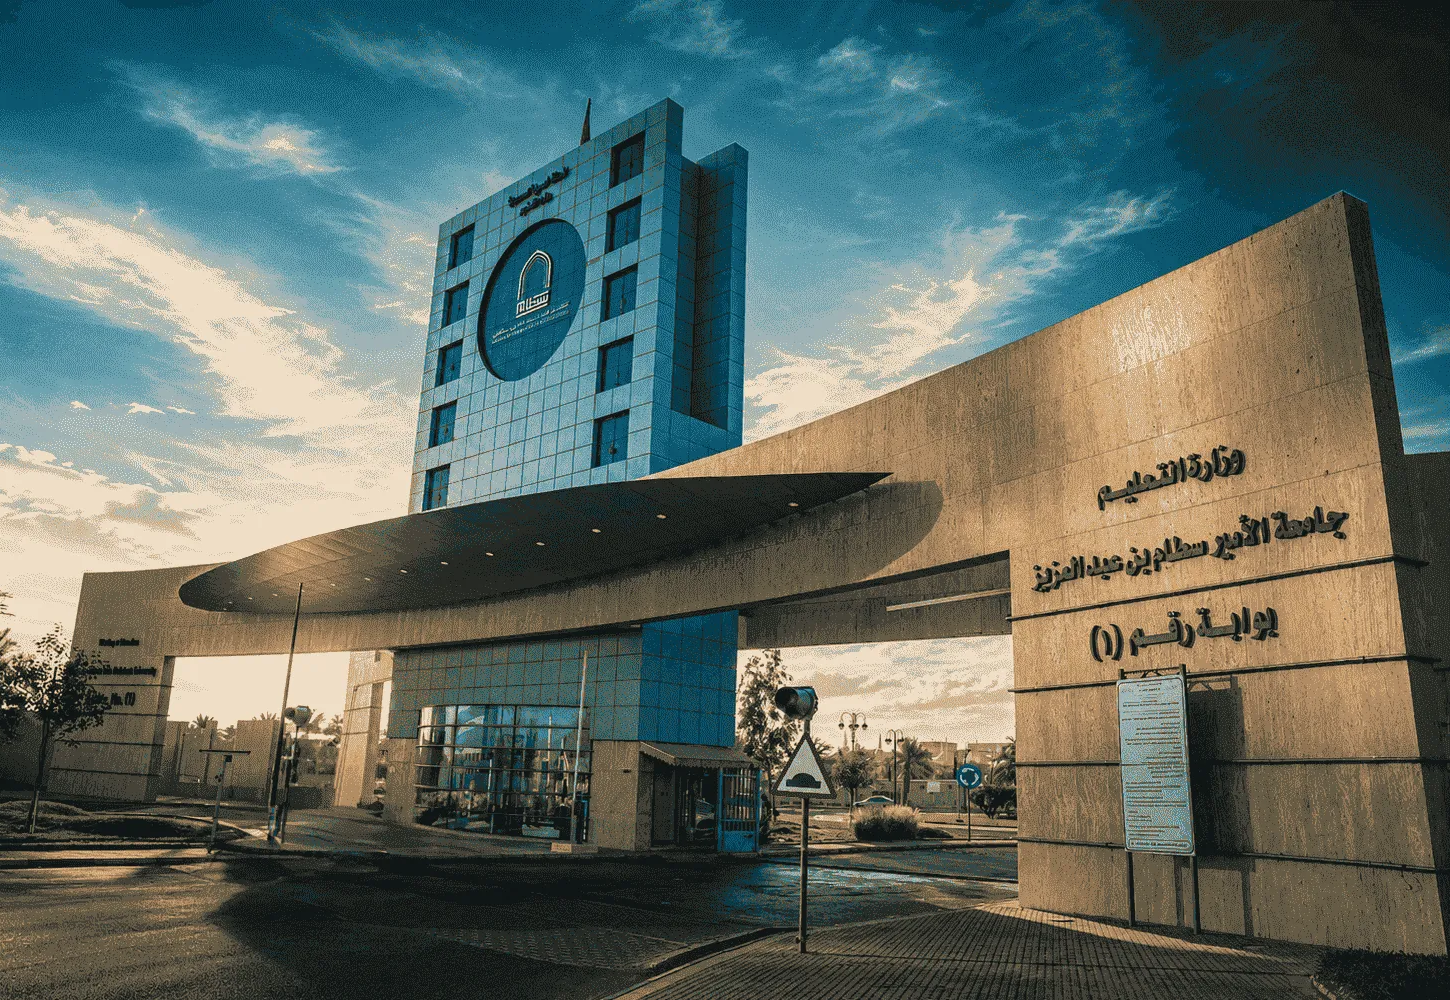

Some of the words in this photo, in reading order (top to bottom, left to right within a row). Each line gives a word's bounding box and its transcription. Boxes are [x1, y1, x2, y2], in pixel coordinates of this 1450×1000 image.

[1187, 444, 1247, 483] وزارة
[1097, 456, 1188, 512] التعليم
[1209, 513, 1271, 561] الأمير
[1270, 505, 1350, 541] جامعة
[1086, 553, 1124, 581] عبد
[1125, 546, 1154, 577] بن
[1153, 535, 1210, 573] سطام
[1031, 555, 1086, 594] العزيز
[1129, 610, 1197, 657] رقم
[1196, 606, 1280, 642] بوابة
